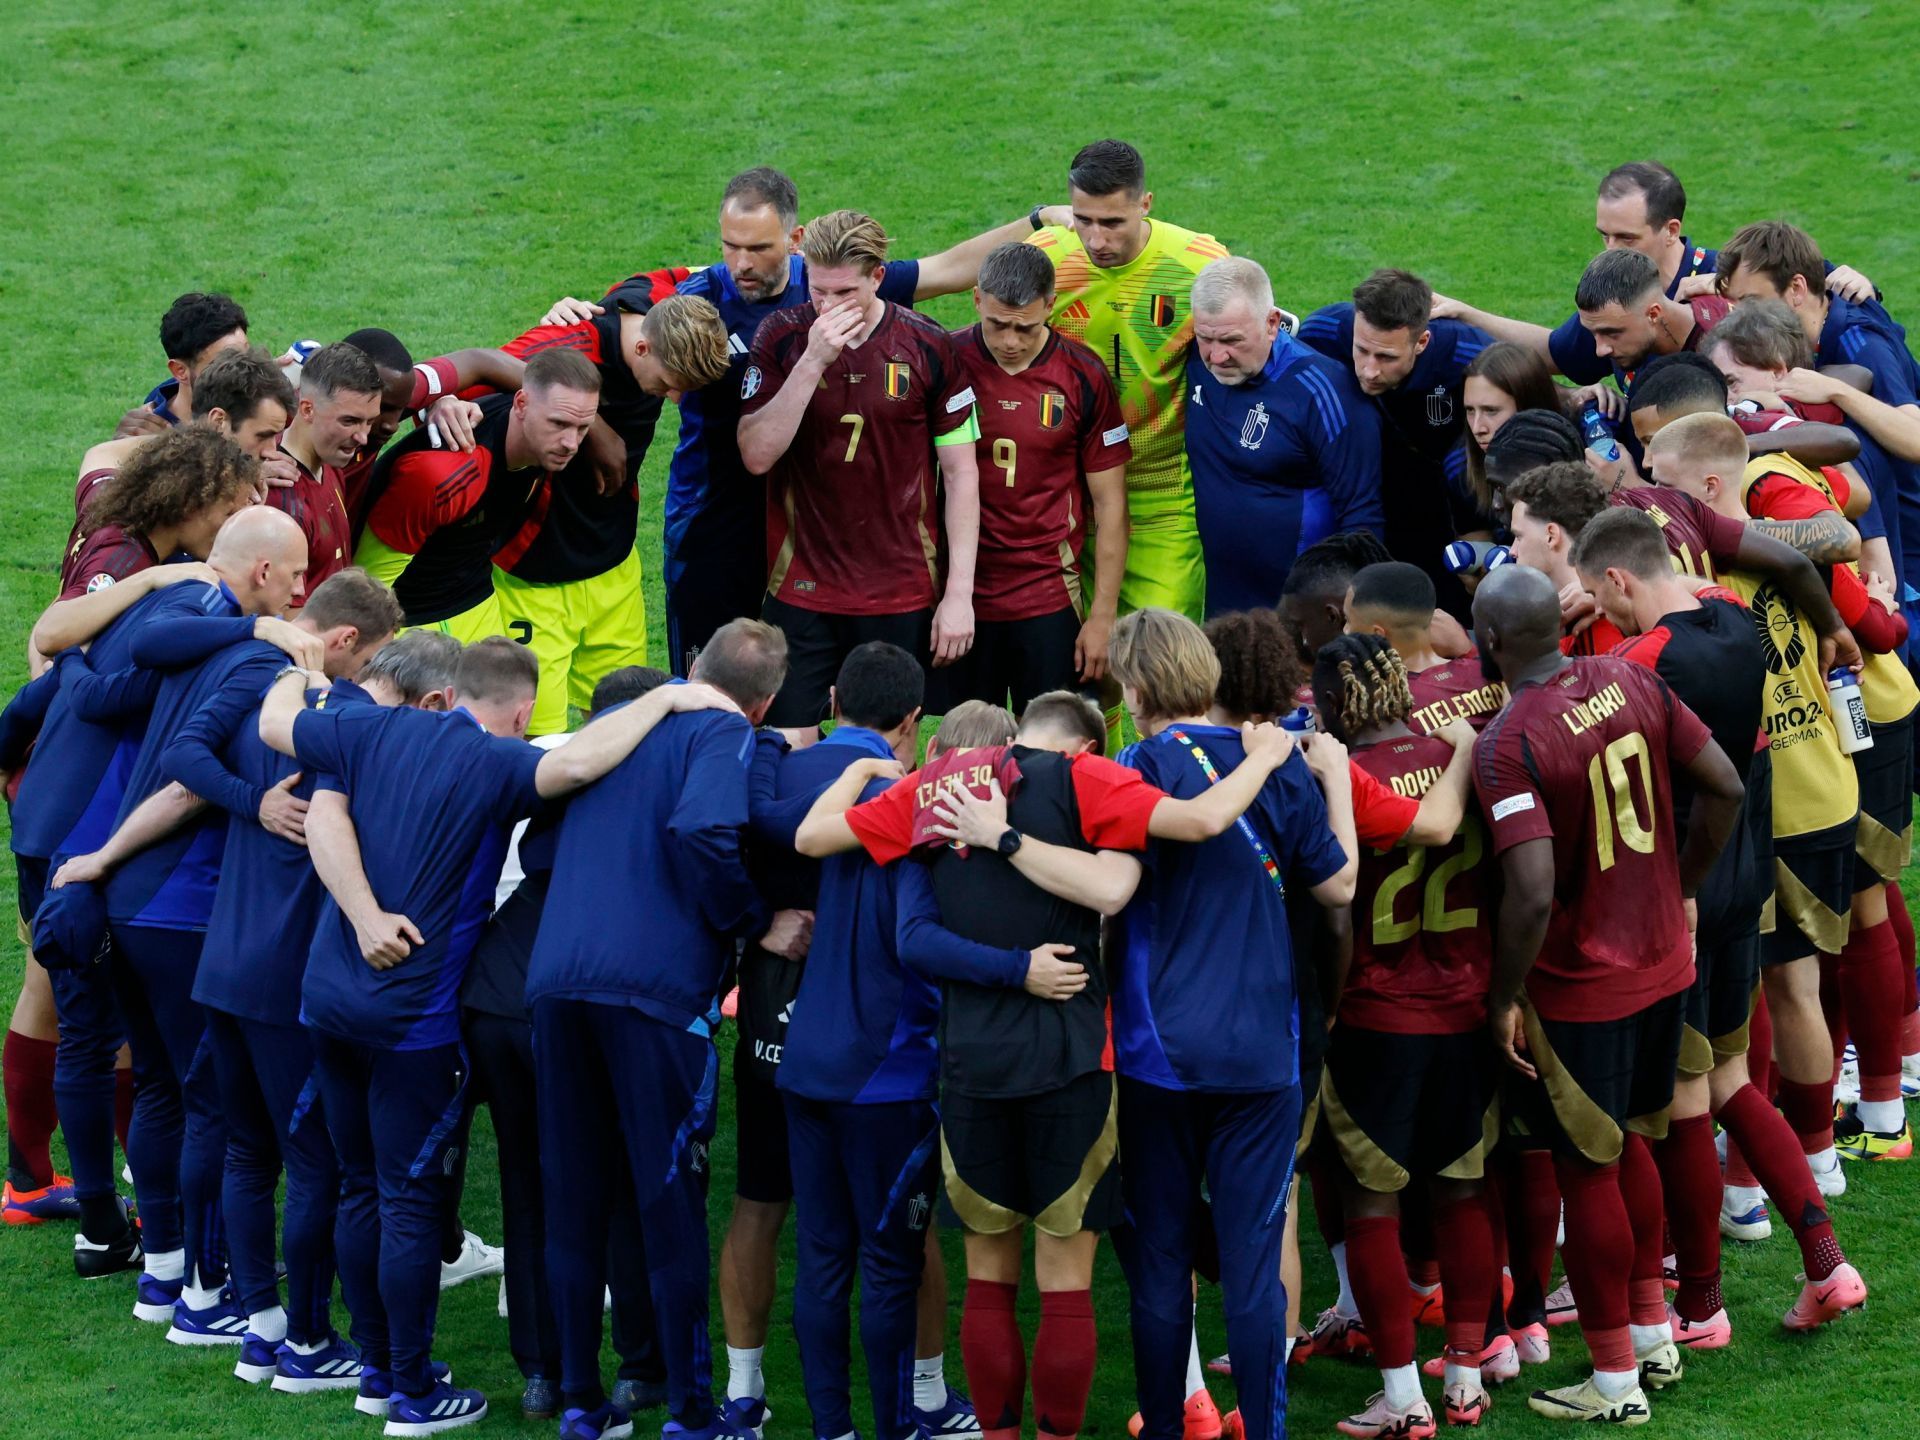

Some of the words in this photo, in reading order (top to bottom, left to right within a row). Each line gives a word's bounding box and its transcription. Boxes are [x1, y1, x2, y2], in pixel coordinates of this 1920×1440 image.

[840, 413, 865, 462] 7
[993, 438, 1017, 487] 9
[1562, 682, 1626, 735] LUKAKU
[1849, 702, 1866, 739] POWER
[1770, 728, 1823, 750] GERMAN
[1589, 732, 1655, 871] 10
[1373, 815, 1483, 945] 22
[755, 1039, 784, 1063] V.CE
